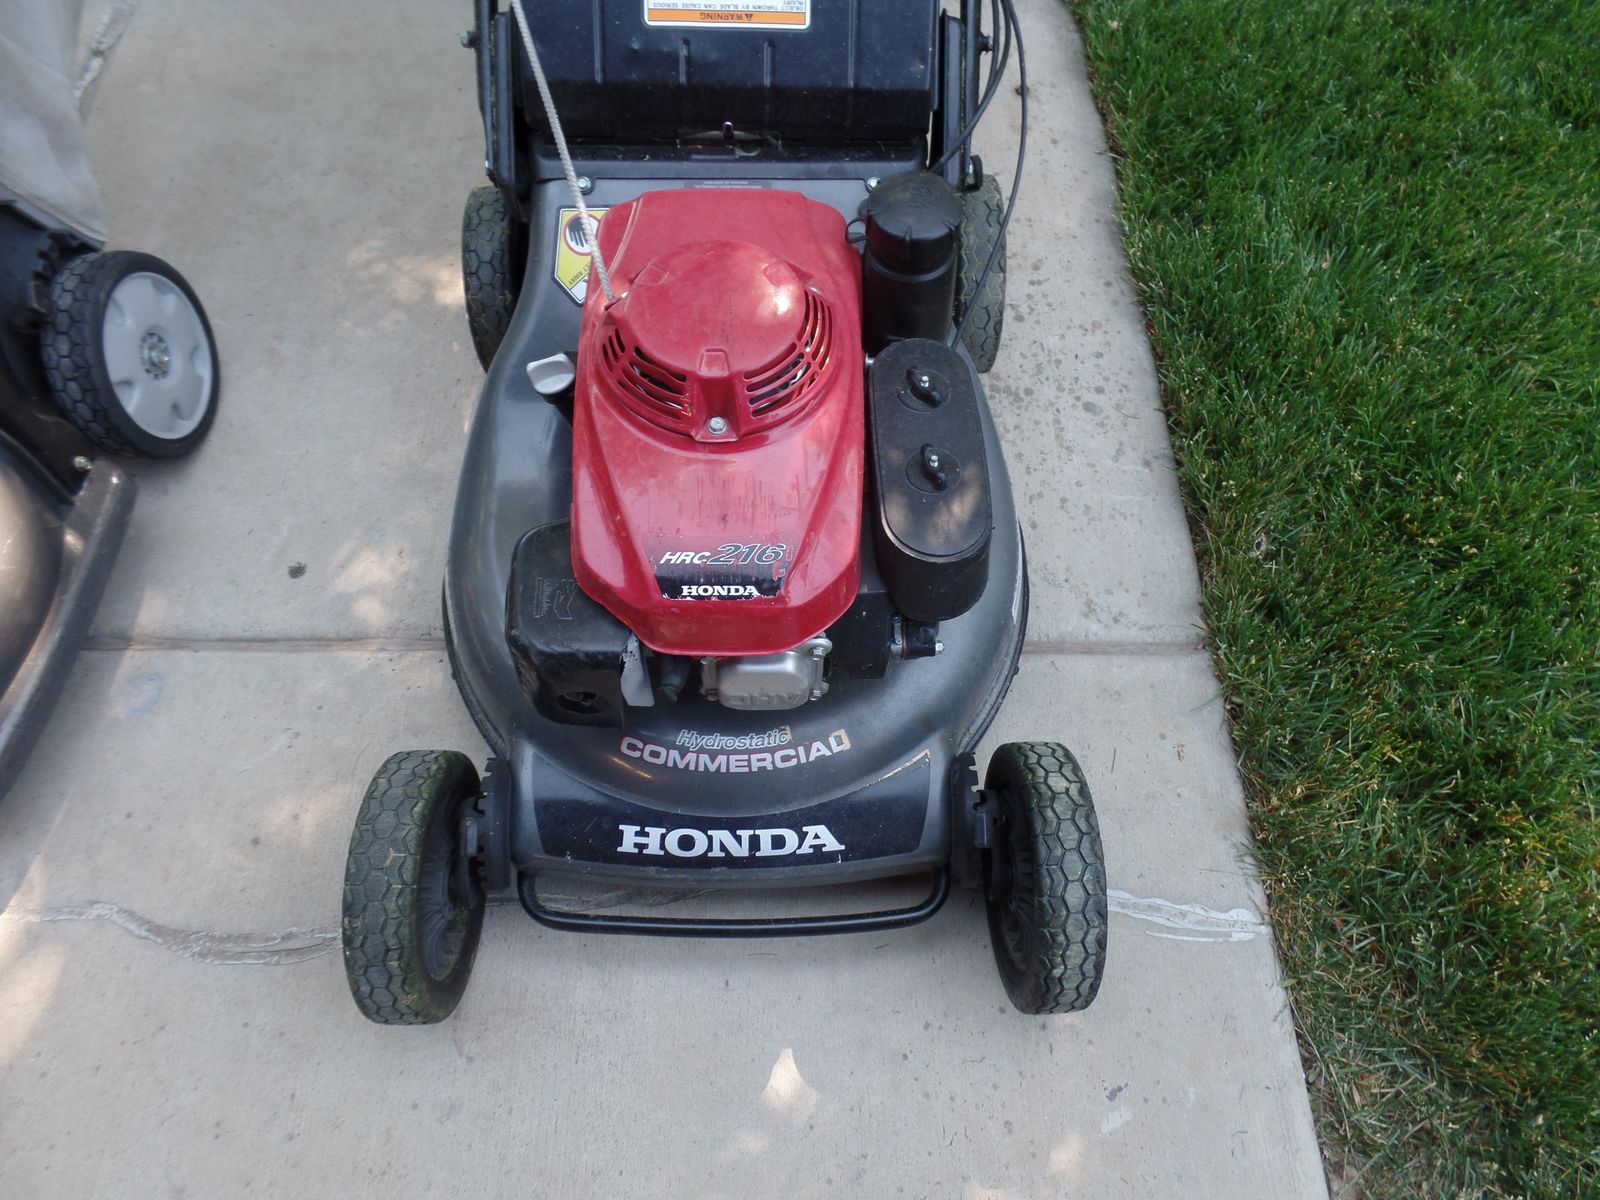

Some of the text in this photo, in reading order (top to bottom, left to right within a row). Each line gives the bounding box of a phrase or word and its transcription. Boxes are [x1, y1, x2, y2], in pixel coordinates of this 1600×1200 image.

[700, 12, 744, 21] WARNING
[568, 269, 583, 286] AWAY
[681, 585, 762, 596] HONDA
[620, 728, 851, 773] COMMERCIAL
[676, 729, 791, 752] Hydrostatic
[616, 824, 846, 858] HONDA
